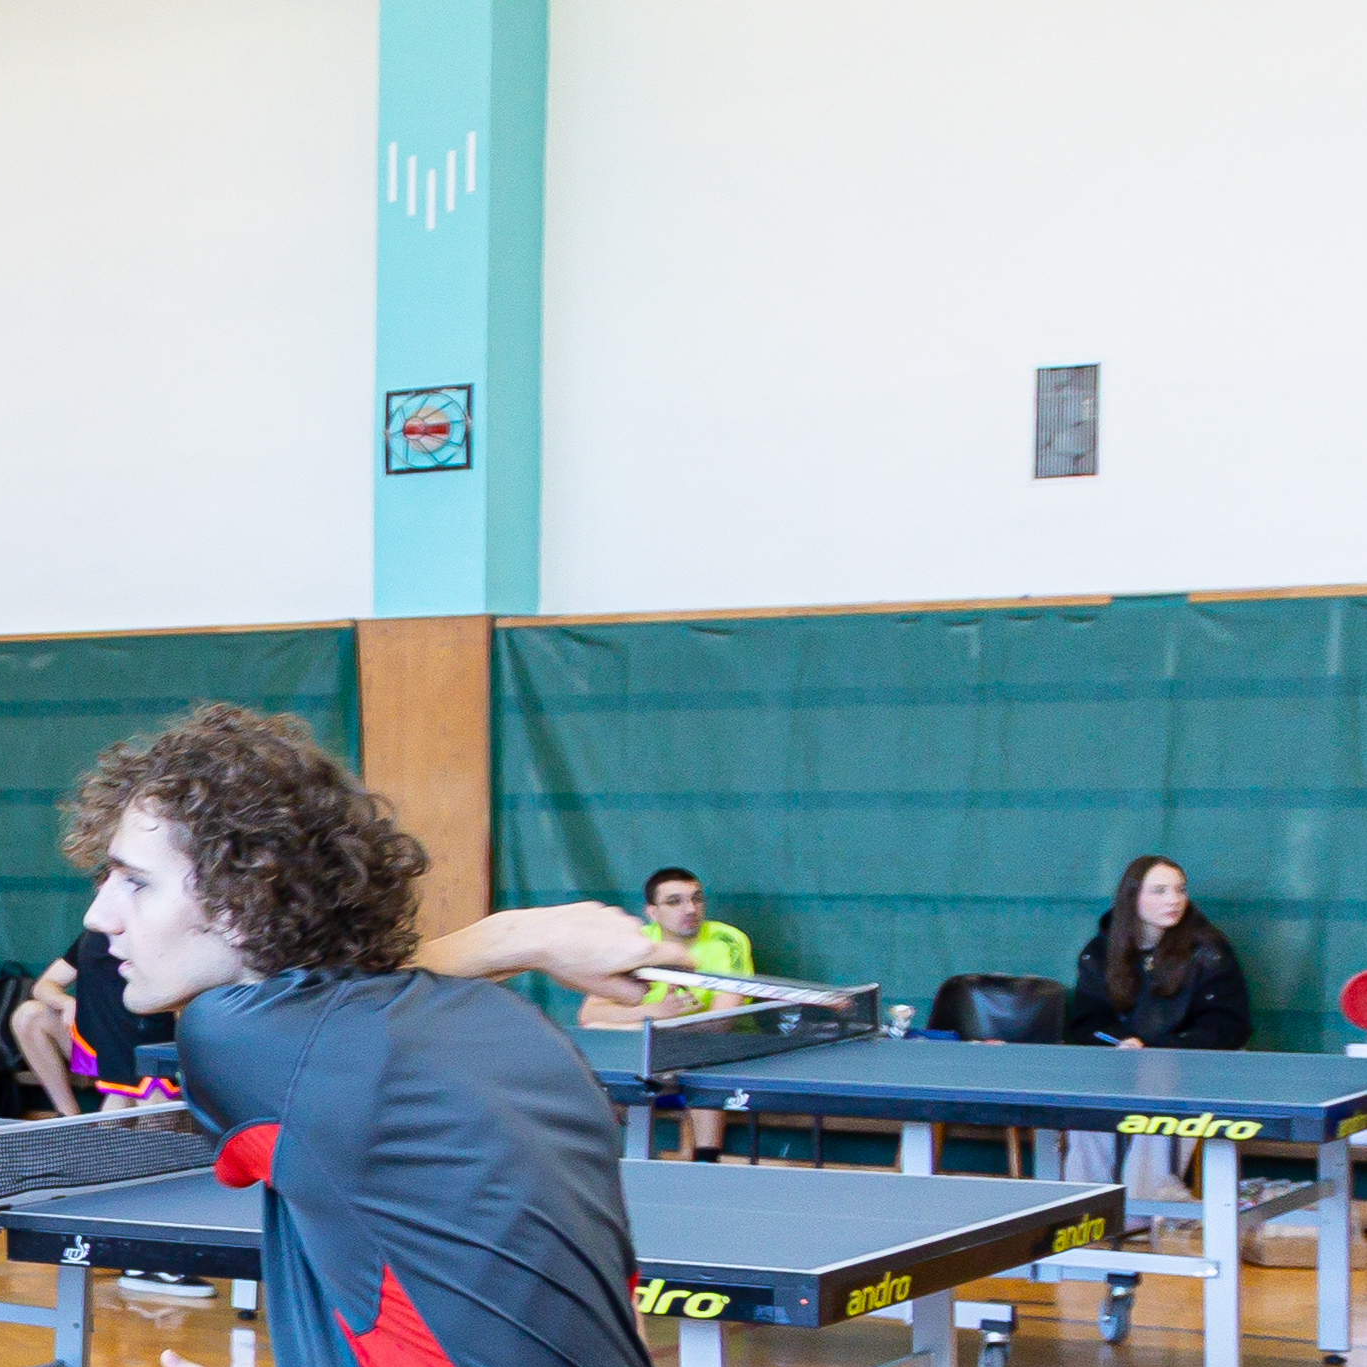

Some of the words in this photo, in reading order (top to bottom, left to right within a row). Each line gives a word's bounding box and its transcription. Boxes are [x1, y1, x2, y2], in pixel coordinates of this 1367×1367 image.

[1116, 1111, 1264, 1141] andro
[1051, 1213, 1106, 1253] andro
[634, 1278, 731, 1318] dro
[845, 1271, 912, 1317] andro
